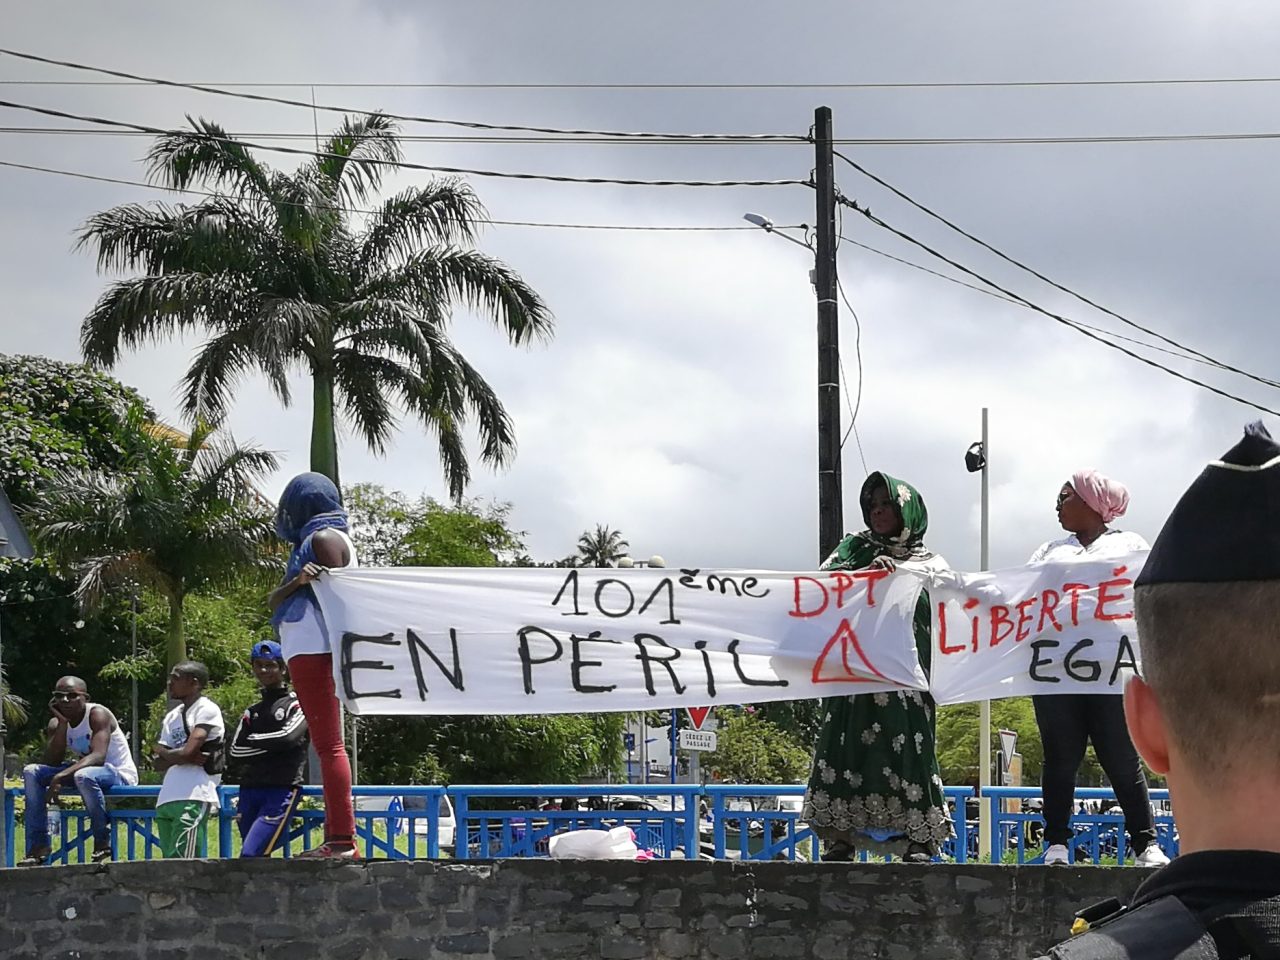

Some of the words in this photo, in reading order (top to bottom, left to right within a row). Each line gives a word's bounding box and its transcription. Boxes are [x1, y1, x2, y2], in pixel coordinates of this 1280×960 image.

[788, 569, 890, 618] DPT
[341, 627, 464, 701] EN
[1029, 635, 1140, 686] EGA
